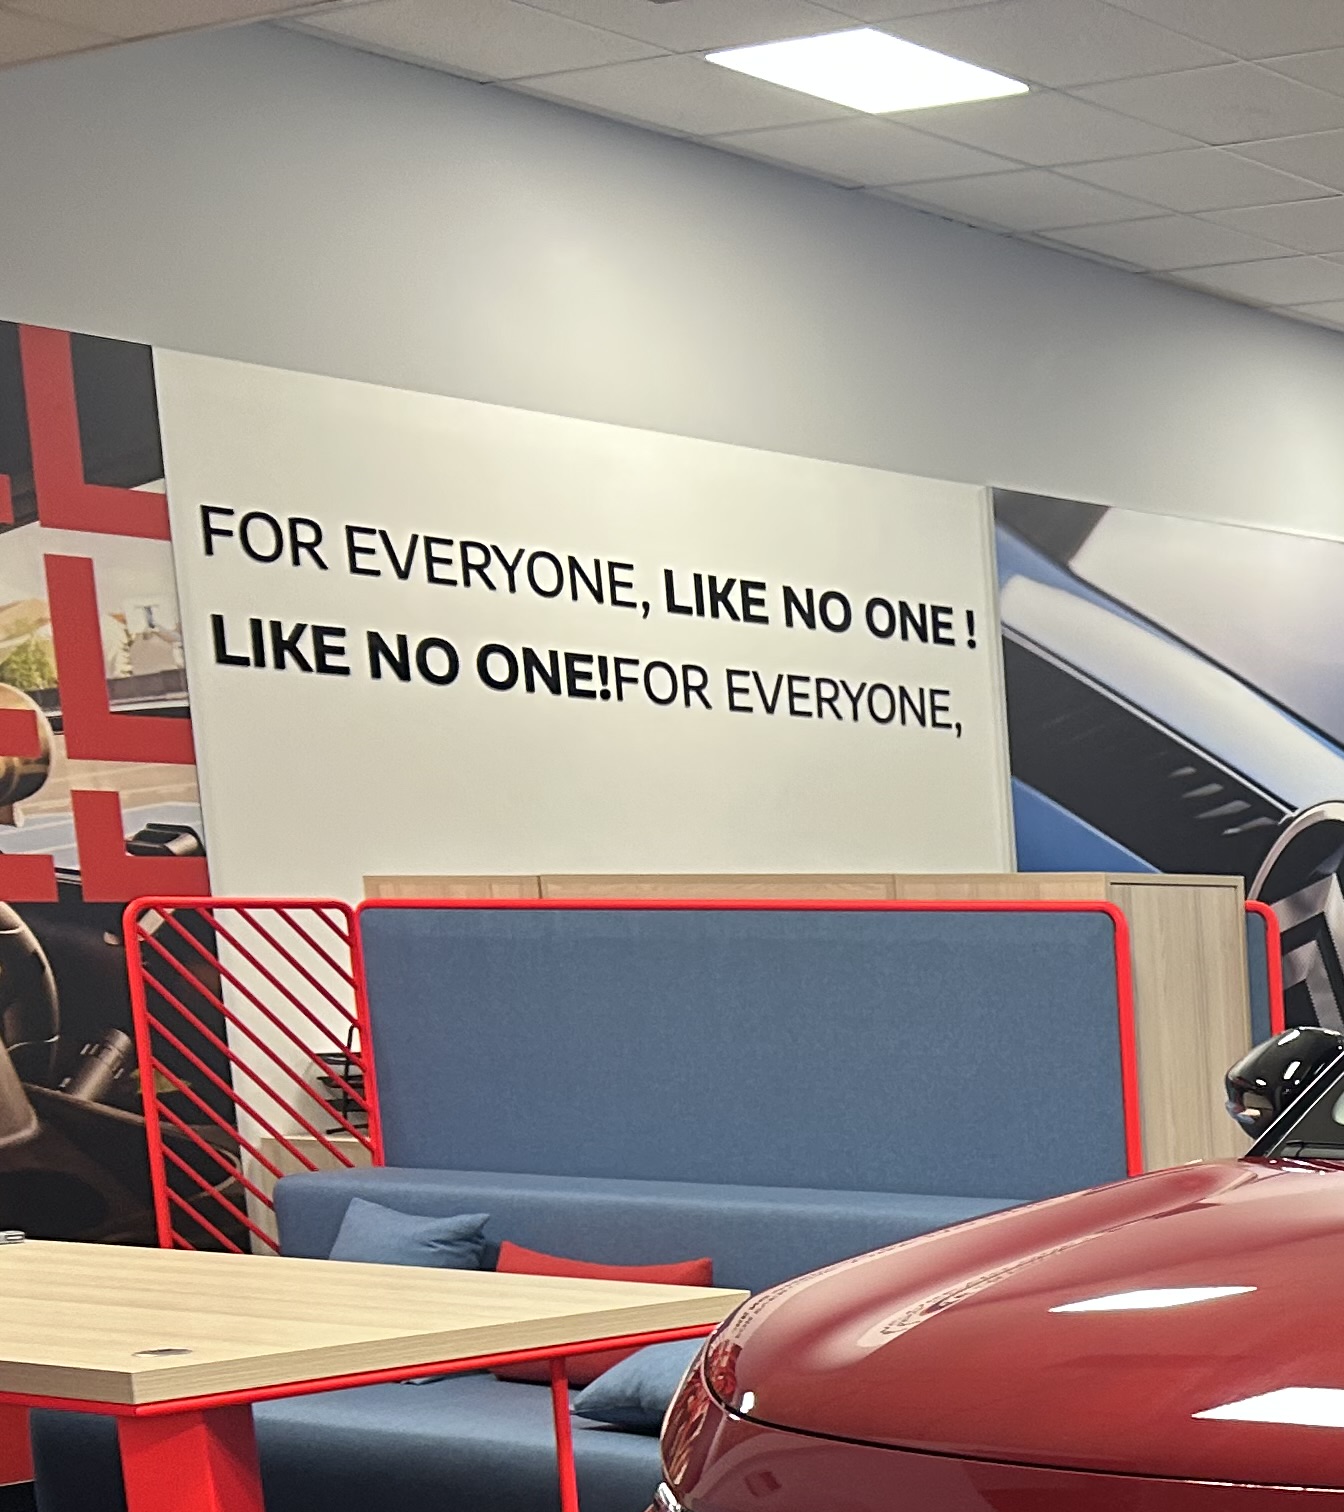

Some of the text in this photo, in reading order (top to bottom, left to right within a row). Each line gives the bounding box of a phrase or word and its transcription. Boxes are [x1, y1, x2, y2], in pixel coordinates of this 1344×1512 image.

[200, 503, 327, 571] FOR
[346, 523, 651, 618] EVERYONE,
[662, 567, 769, 626] LIKE
[782, 586, 852, 634] NO
[864, 595, 954, 646] ONE
[210, 612, 351, 677] LIKE
[368, 628, 460, 685] NO
[726, 668, 964, 738] EVERYONE,
